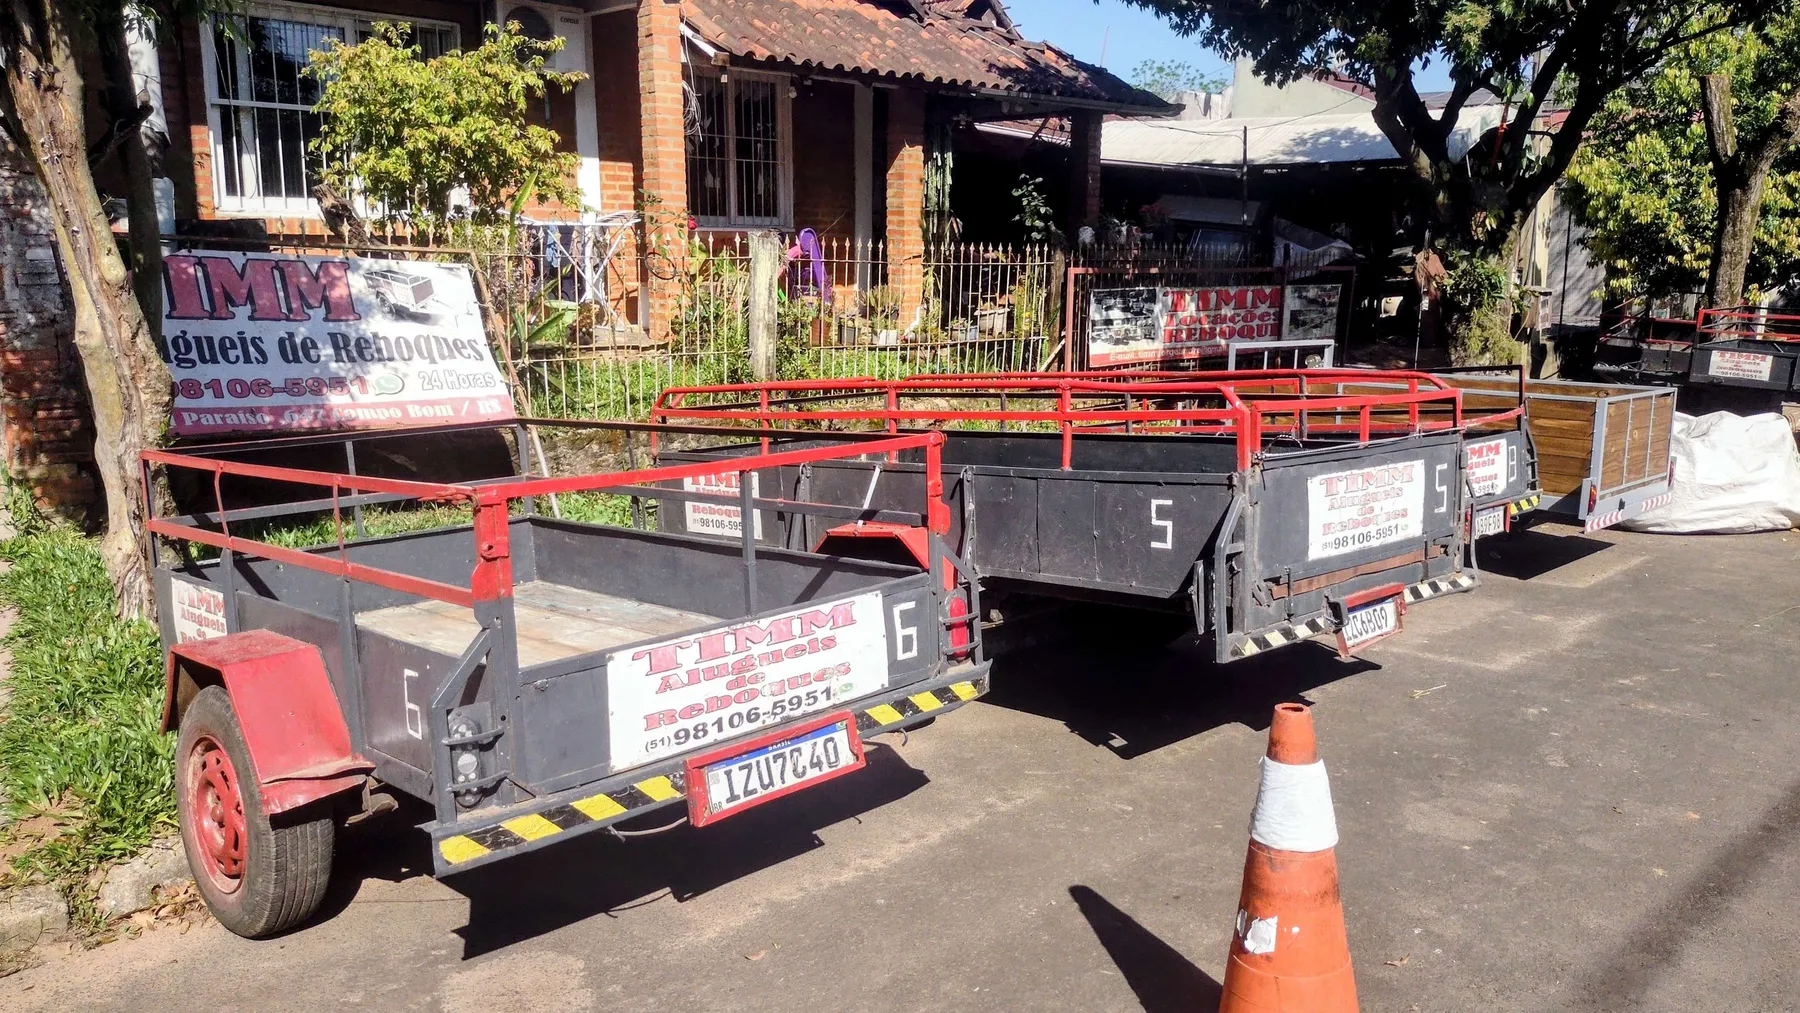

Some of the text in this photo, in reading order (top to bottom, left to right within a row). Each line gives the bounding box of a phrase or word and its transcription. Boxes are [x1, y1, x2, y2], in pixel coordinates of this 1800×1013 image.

[163, 255, 361, 321] IMM
[1163, 288, 1281, 312] TIMM
[277, 331, 322, 364] de
[327, 332, 485, 364] Reboques
[1717, 351, 1767, 362] TIMM
[418, 370, 444, 390] 24
[443, 369, 496, 390] Horas
[181, 410, 271, 426] Paraíso
[332, 404, 402, 421] Campo
[406, 402, 454, 418] Bom
[477, 398, 500, 414] RS
[1468, 442, 1501, 460] MM
[1319, 464, 1415, 498] TIMM
[1434, 462, 1449, 513] 5
[692, 505, 741, 519] Reboqu
[1328, 487, 1404, 511] Alugueis
[1357, 506, 1375, 517] de
[1150, 499, 1173, 549] 5
[1322, 508, 1408, 536] Reboques
[1322, 524, 1399, 551] (51) 98106-5951
[176, 586, 226, 618] TIMM
[181, 606, 226, 634] Alugueis
[196, 628, 207, 640] de
[891, 600, 918, 661] 6
[631, 601, 857, 676] TIMM
[655, 634, 838, 694] Alugueis
[725, 671, 766, 691] de
[403, 668, 423, 740] 6
[644, 662, 852, 732] Reboques
[645, 686, 833, 753] (51) 98106-5951
[723, 736, 840, 804] IZU7C40
